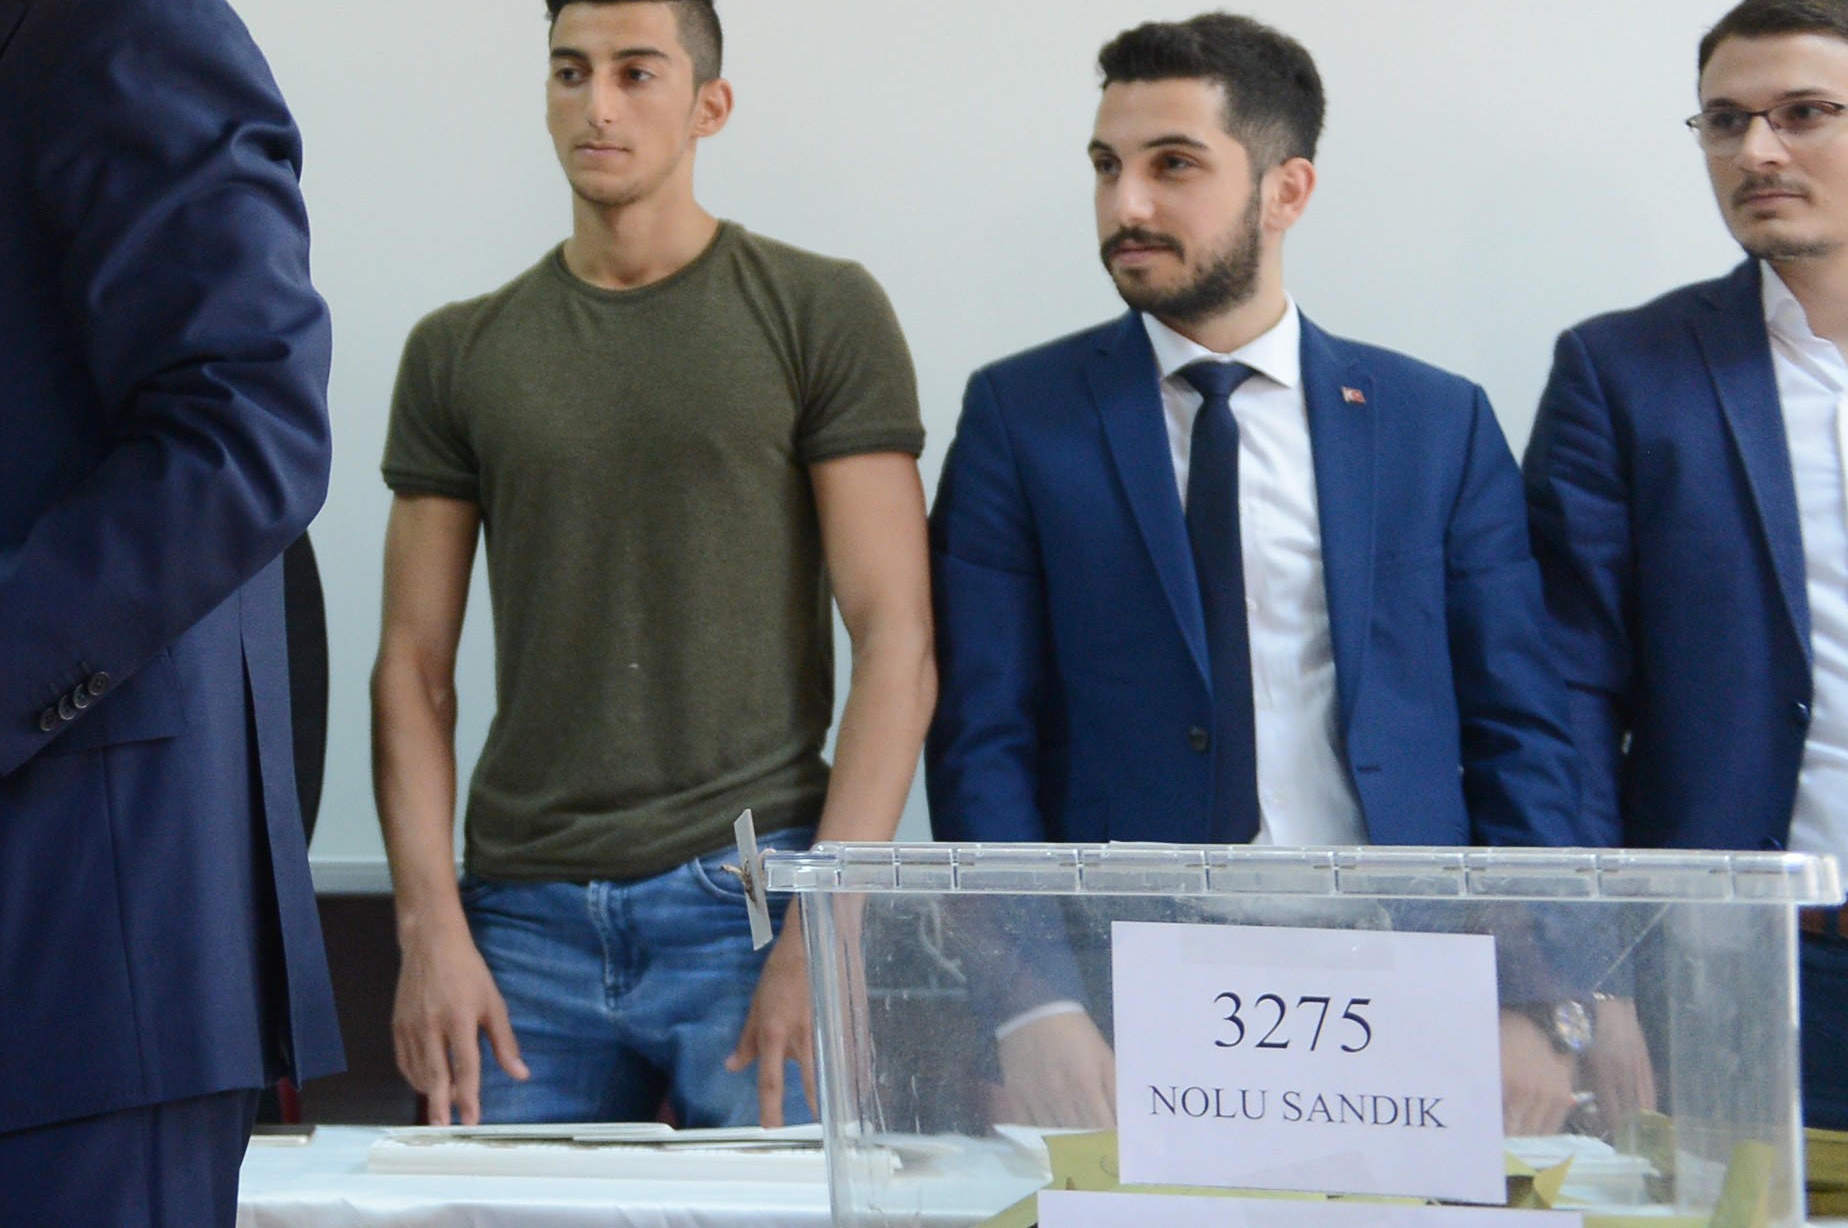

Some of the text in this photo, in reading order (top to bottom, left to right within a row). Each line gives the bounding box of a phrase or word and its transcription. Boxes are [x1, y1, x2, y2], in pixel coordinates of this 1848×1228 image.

[1213, 991, 1372, 1053] 3275
[1148, 1085, 1448, 1129] NOLU SANDIK
